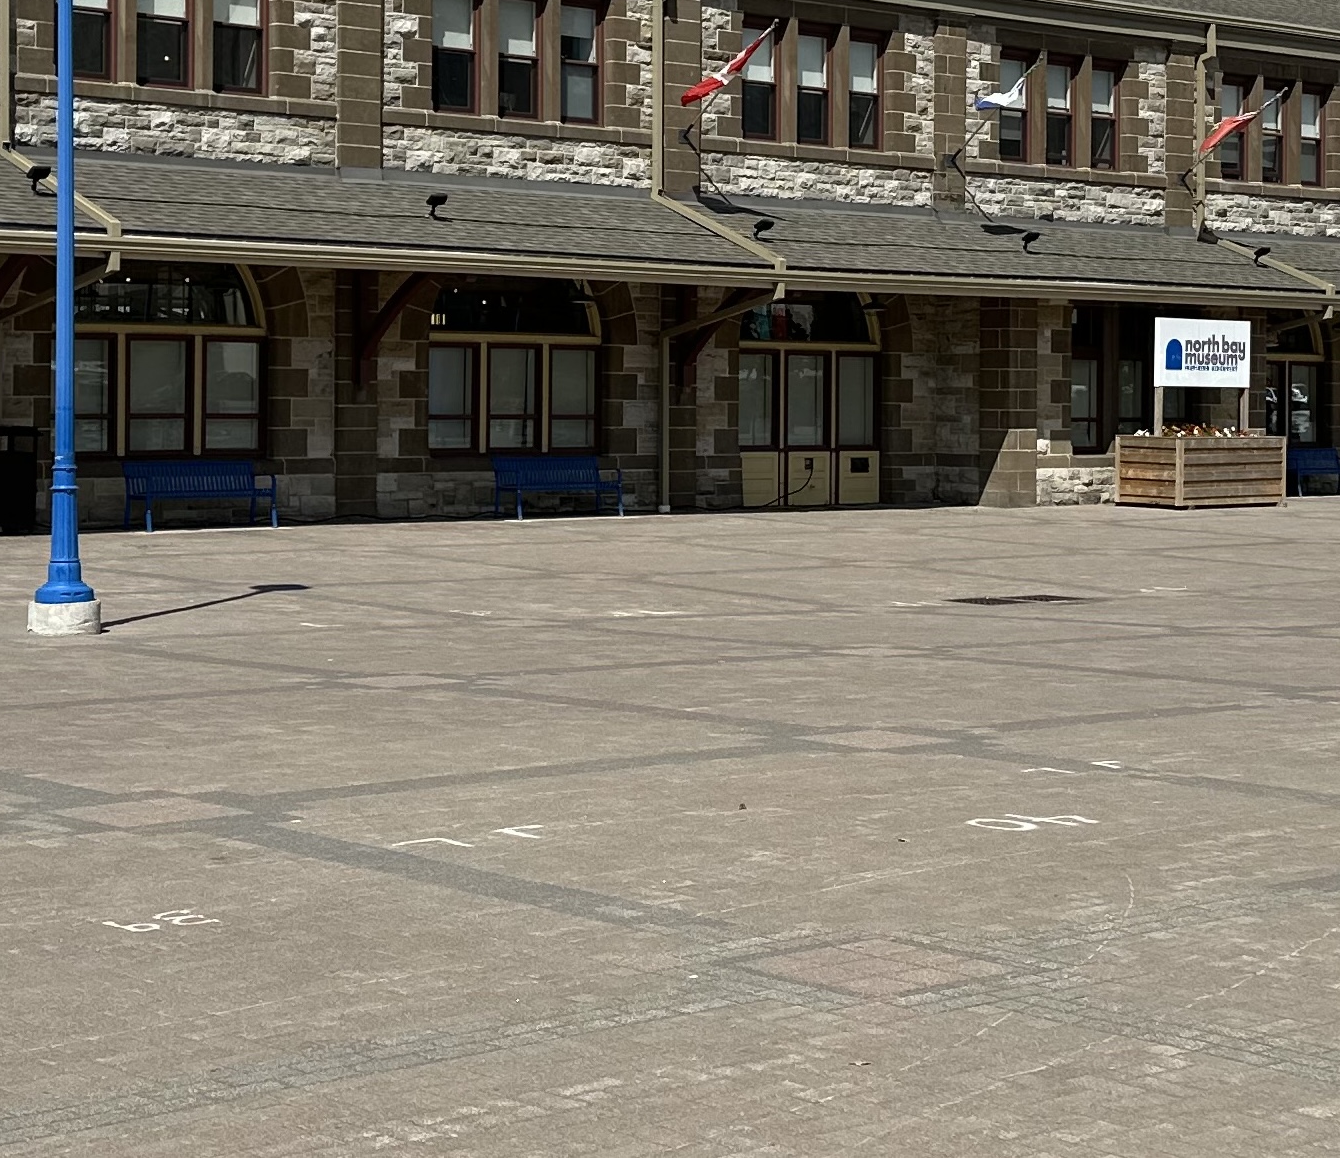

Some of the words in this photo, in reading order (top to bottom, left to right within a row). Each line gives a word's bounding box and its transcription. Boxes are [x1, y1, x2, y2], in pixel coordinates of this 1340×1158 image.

[1184, 334, 1220, 353] north
[1221, 334, 1246, 361] bay
[1184, 352, 1238, 366] museum
